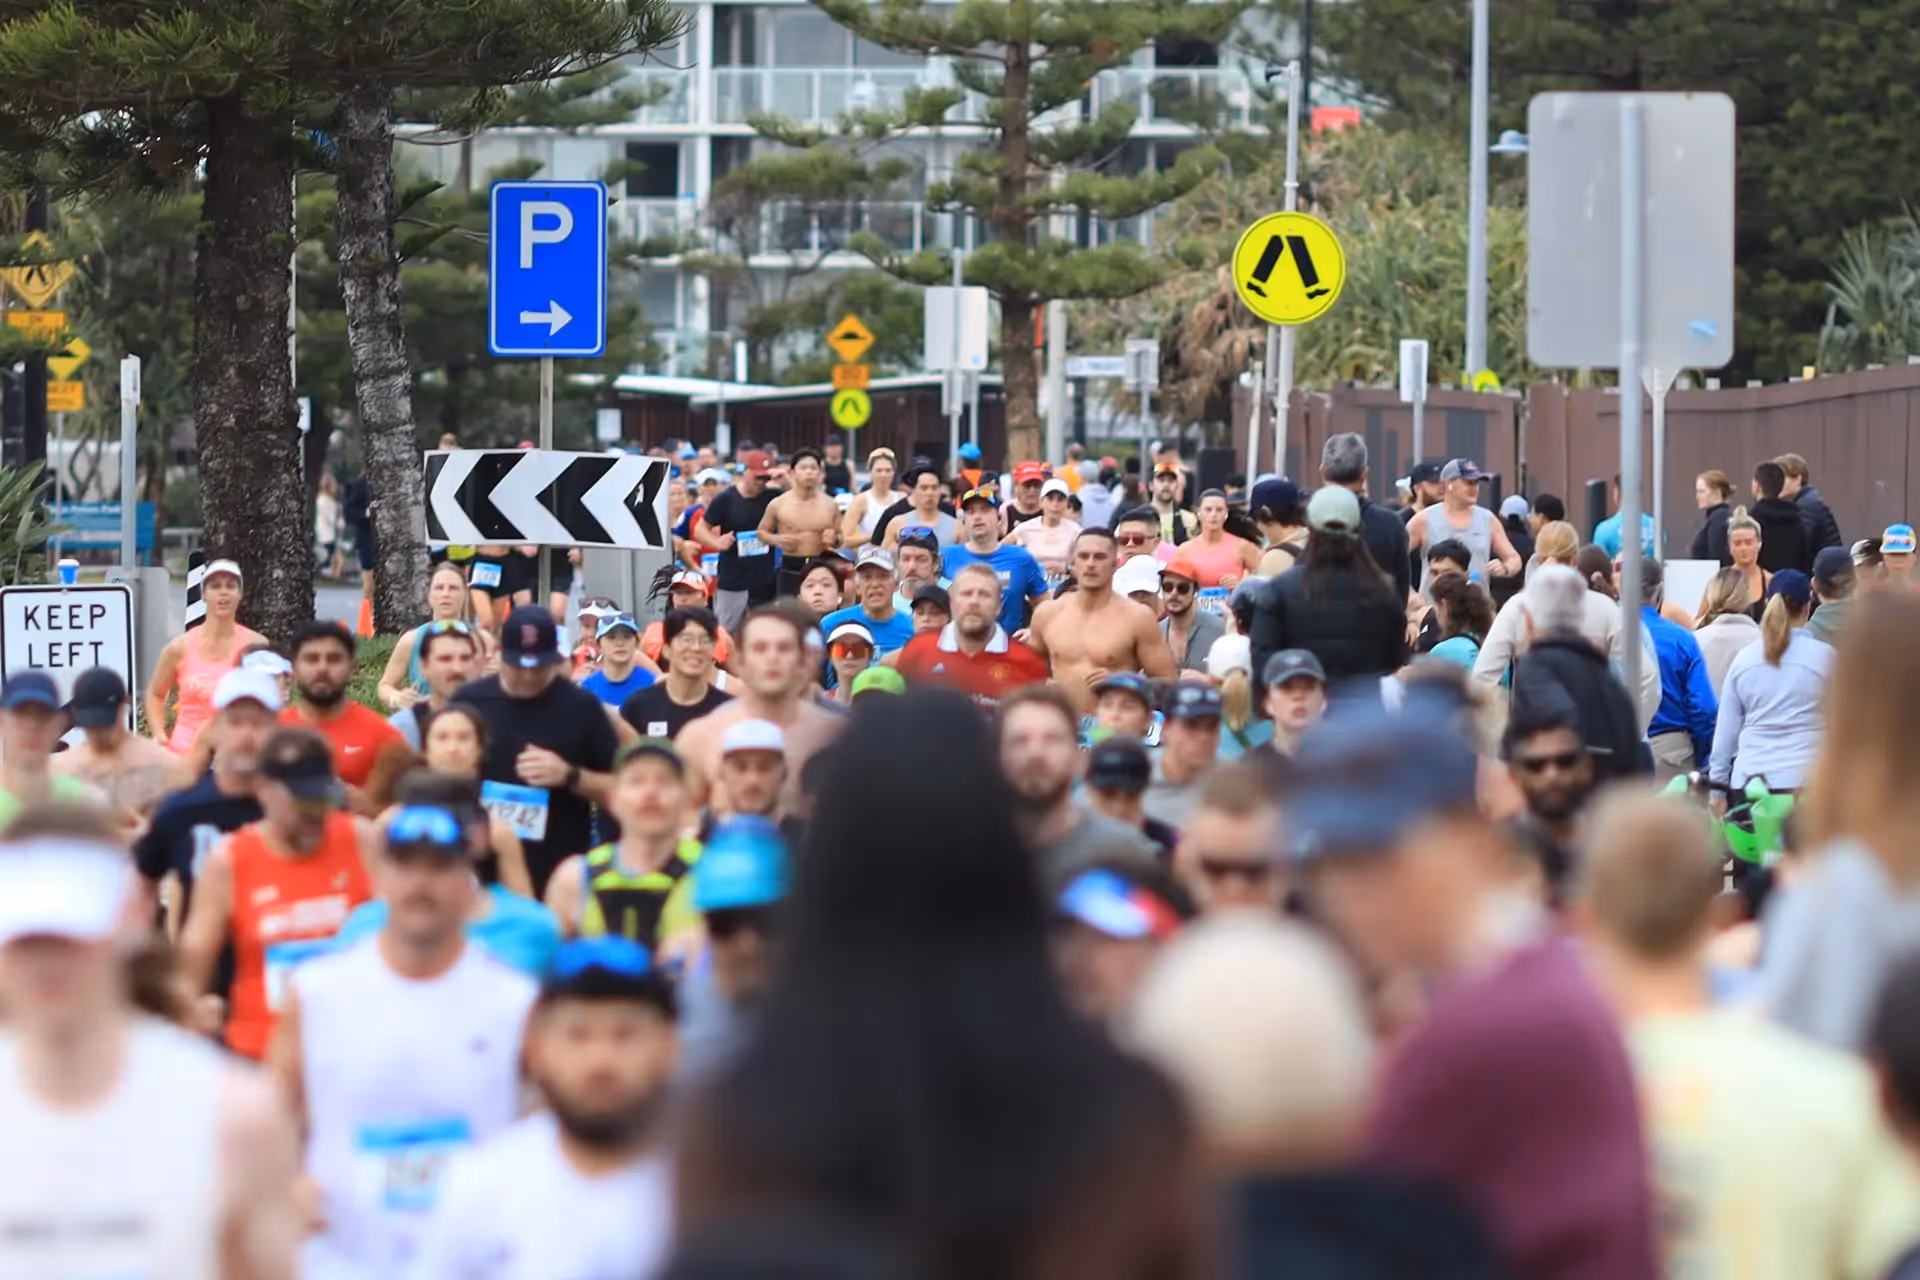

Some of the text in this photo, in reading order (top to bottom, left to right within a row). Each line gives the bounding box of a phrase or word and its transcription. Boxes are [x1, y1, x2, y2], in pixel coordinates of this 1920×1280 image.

[520, 201, 573, 269] P
[24, 604, 106, 630] KEEP
[28, 641, 103, 668] LEFT
